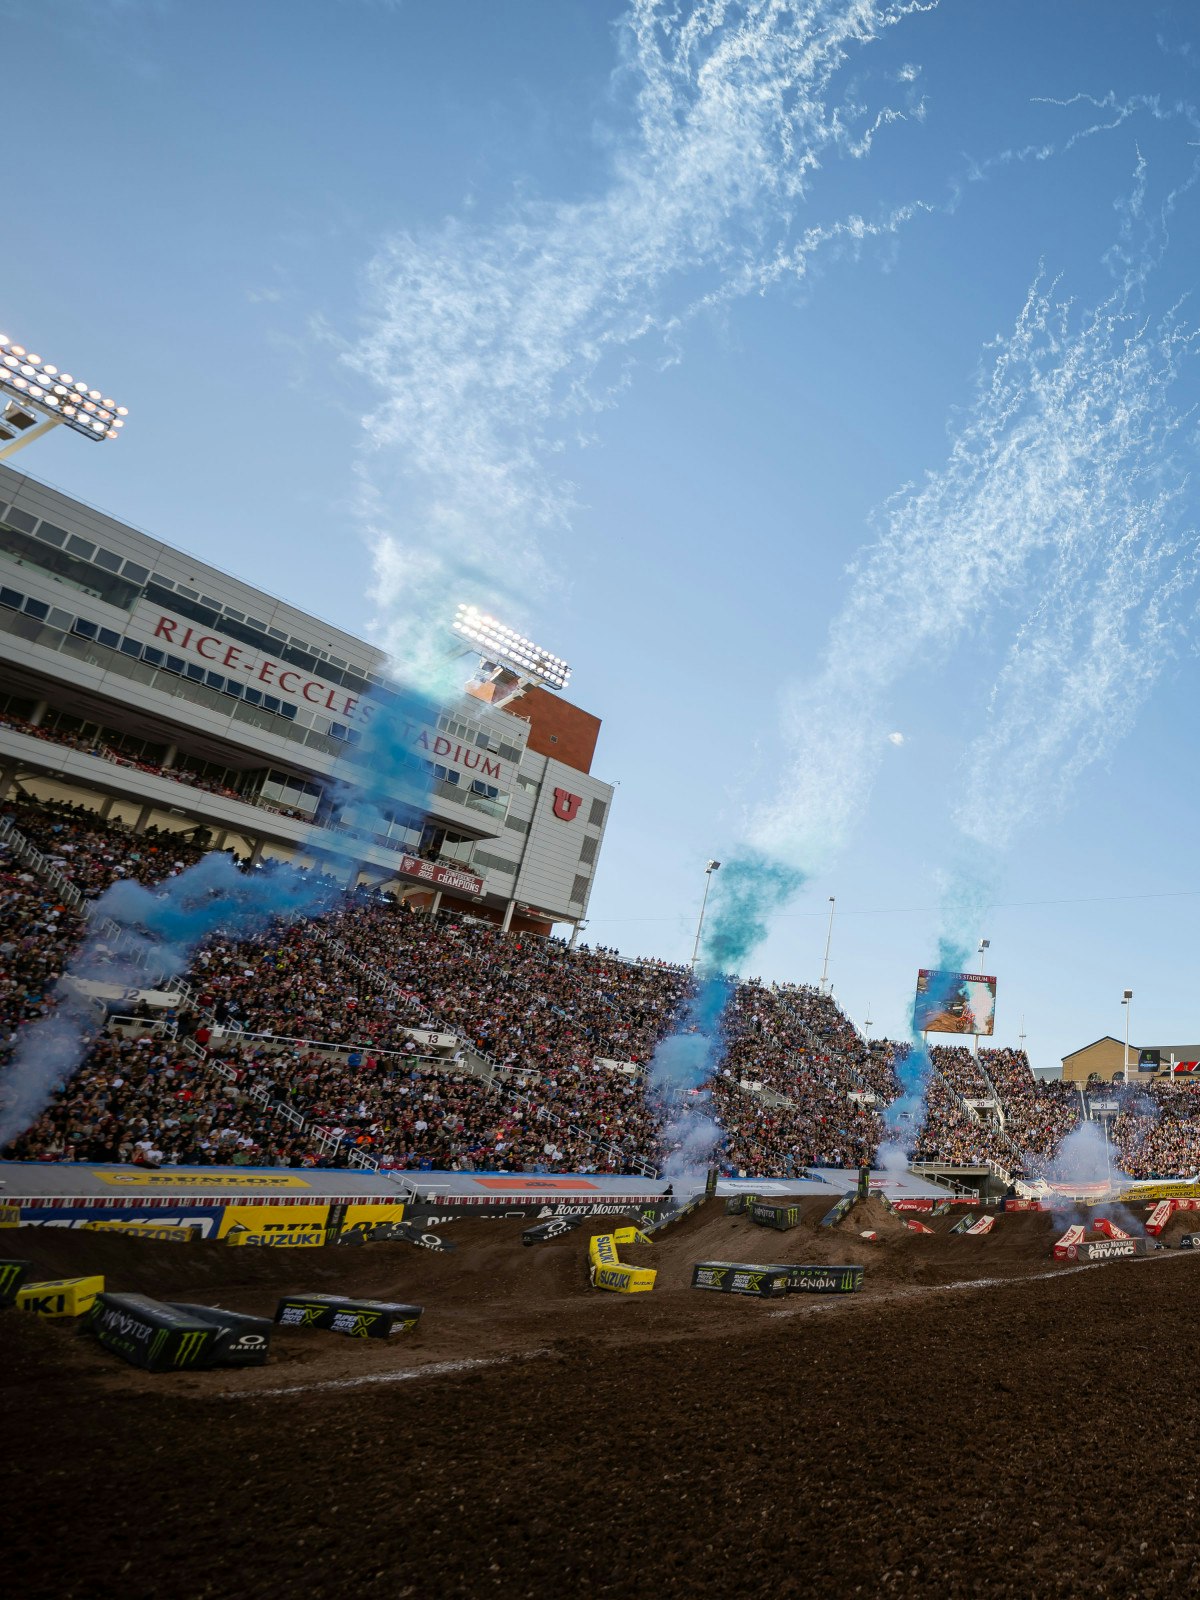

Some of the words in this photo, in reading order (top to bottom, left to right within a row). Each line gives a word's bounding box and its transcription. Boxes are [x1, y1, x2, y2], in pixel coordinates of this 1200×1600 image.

[154, 616, 375, 725] RICE-ECCLES
[553, 787, 583, 822] U
[420, 862, 435, 873] 2021
[418, 869, 434, 880] 2022
[445, 869, 476, 884] CONFERENCE
[437, 873, 480, 893] CHAMPIONS
[963, 974, 988, 982] STADIUM
[121, 988, 140, 1000] 12
[427, 1034, 439, 1044] 13
[616, 1062, 625, 1070] 14
[149, 1176, 289, 1184] DUNLOP
[554, 1204, 588, 1216] ROCKY
[588, 1204, 641, 1215] MOUNTN
[543, 1226, 573, 1240] OAKLEY
[246, 1233, 321, 1247] SUZUKI
[414, 1240, 445, 1252] OAKLEY
[1111, 1240, 1134, 1248] MOUNTAIN
[597, 1236, 614, 1263] SUZUKI
[600, 1270, 631, 1289] SUZUKI
[283, 1307, 304, 1315] SUPER
[102, 1308, 152, 1343] MONSTER
